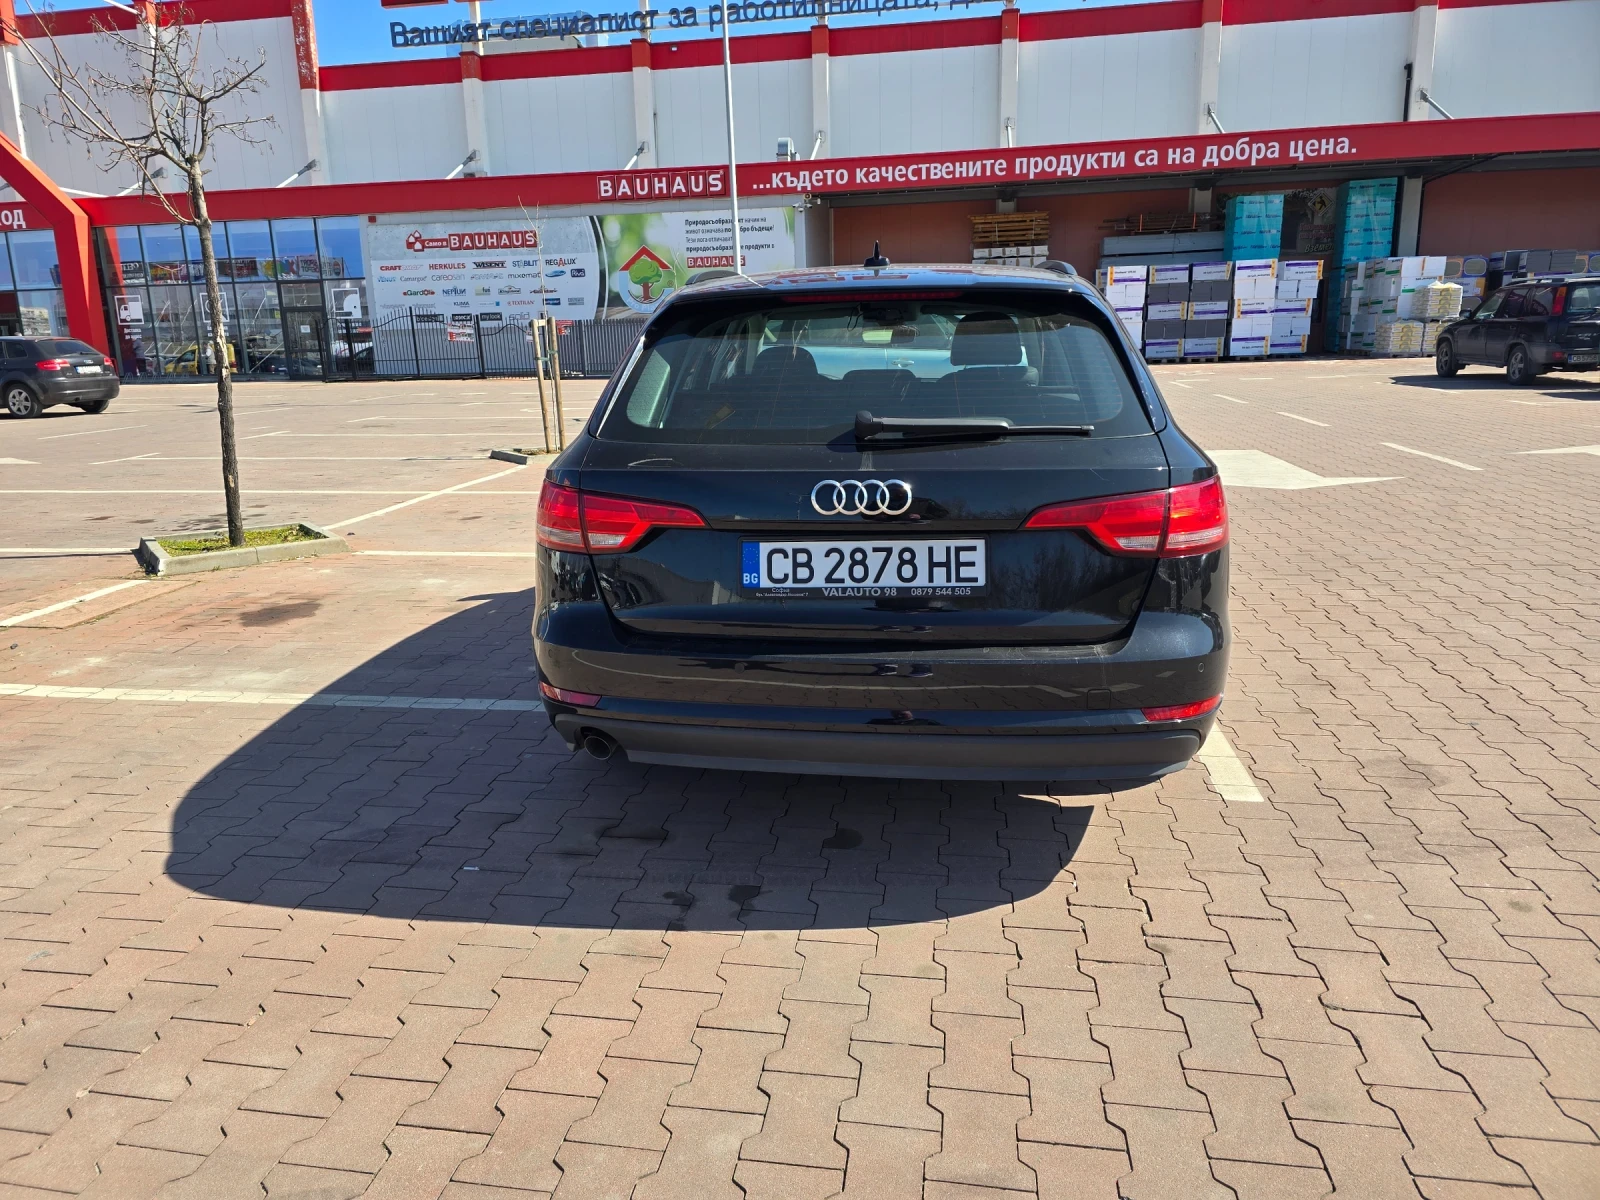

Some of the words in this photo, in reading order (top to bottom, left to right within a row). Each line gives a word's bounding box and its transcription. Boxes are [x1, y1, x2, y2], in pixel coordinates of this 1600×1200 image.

[390, 21, 491, 47] Вашият
[668, 6, 699, 27] за
[753, 168, 848, 190] ...където
[856, 159, 1007, 183] качествените
[1015, 150, 1125, 179] продукти
[1134, 148, 1158, 166] са
[1168, 146, 1195, 164] на
[1202, 137, 1280, 167] добра
[1289, 137, 1357, 161] цена.
[600, 174, 723, 197] BAUHAUS
[0, 209, 26, 230] ОД
[450, 231, 536, 248] BAUHAUS
[428, 262, 466, 270] HERKULES
[472, 260, 507, 269] WISENT
[545, 258, 577, 267] REGALUX
[767, 548, 814, 584] CB
[824, 547, 918, 584] 2878
[928, 545, 978, 584] HE
[743, 573, 758, 584] BG
[822, 587, 880, 597] VALAUTO
[884, 587, 897, 597] 98
[911, 587, 934, 596] 0879
[935, 587, 952, 596] 544
[954, 587, 971, 596] 505
